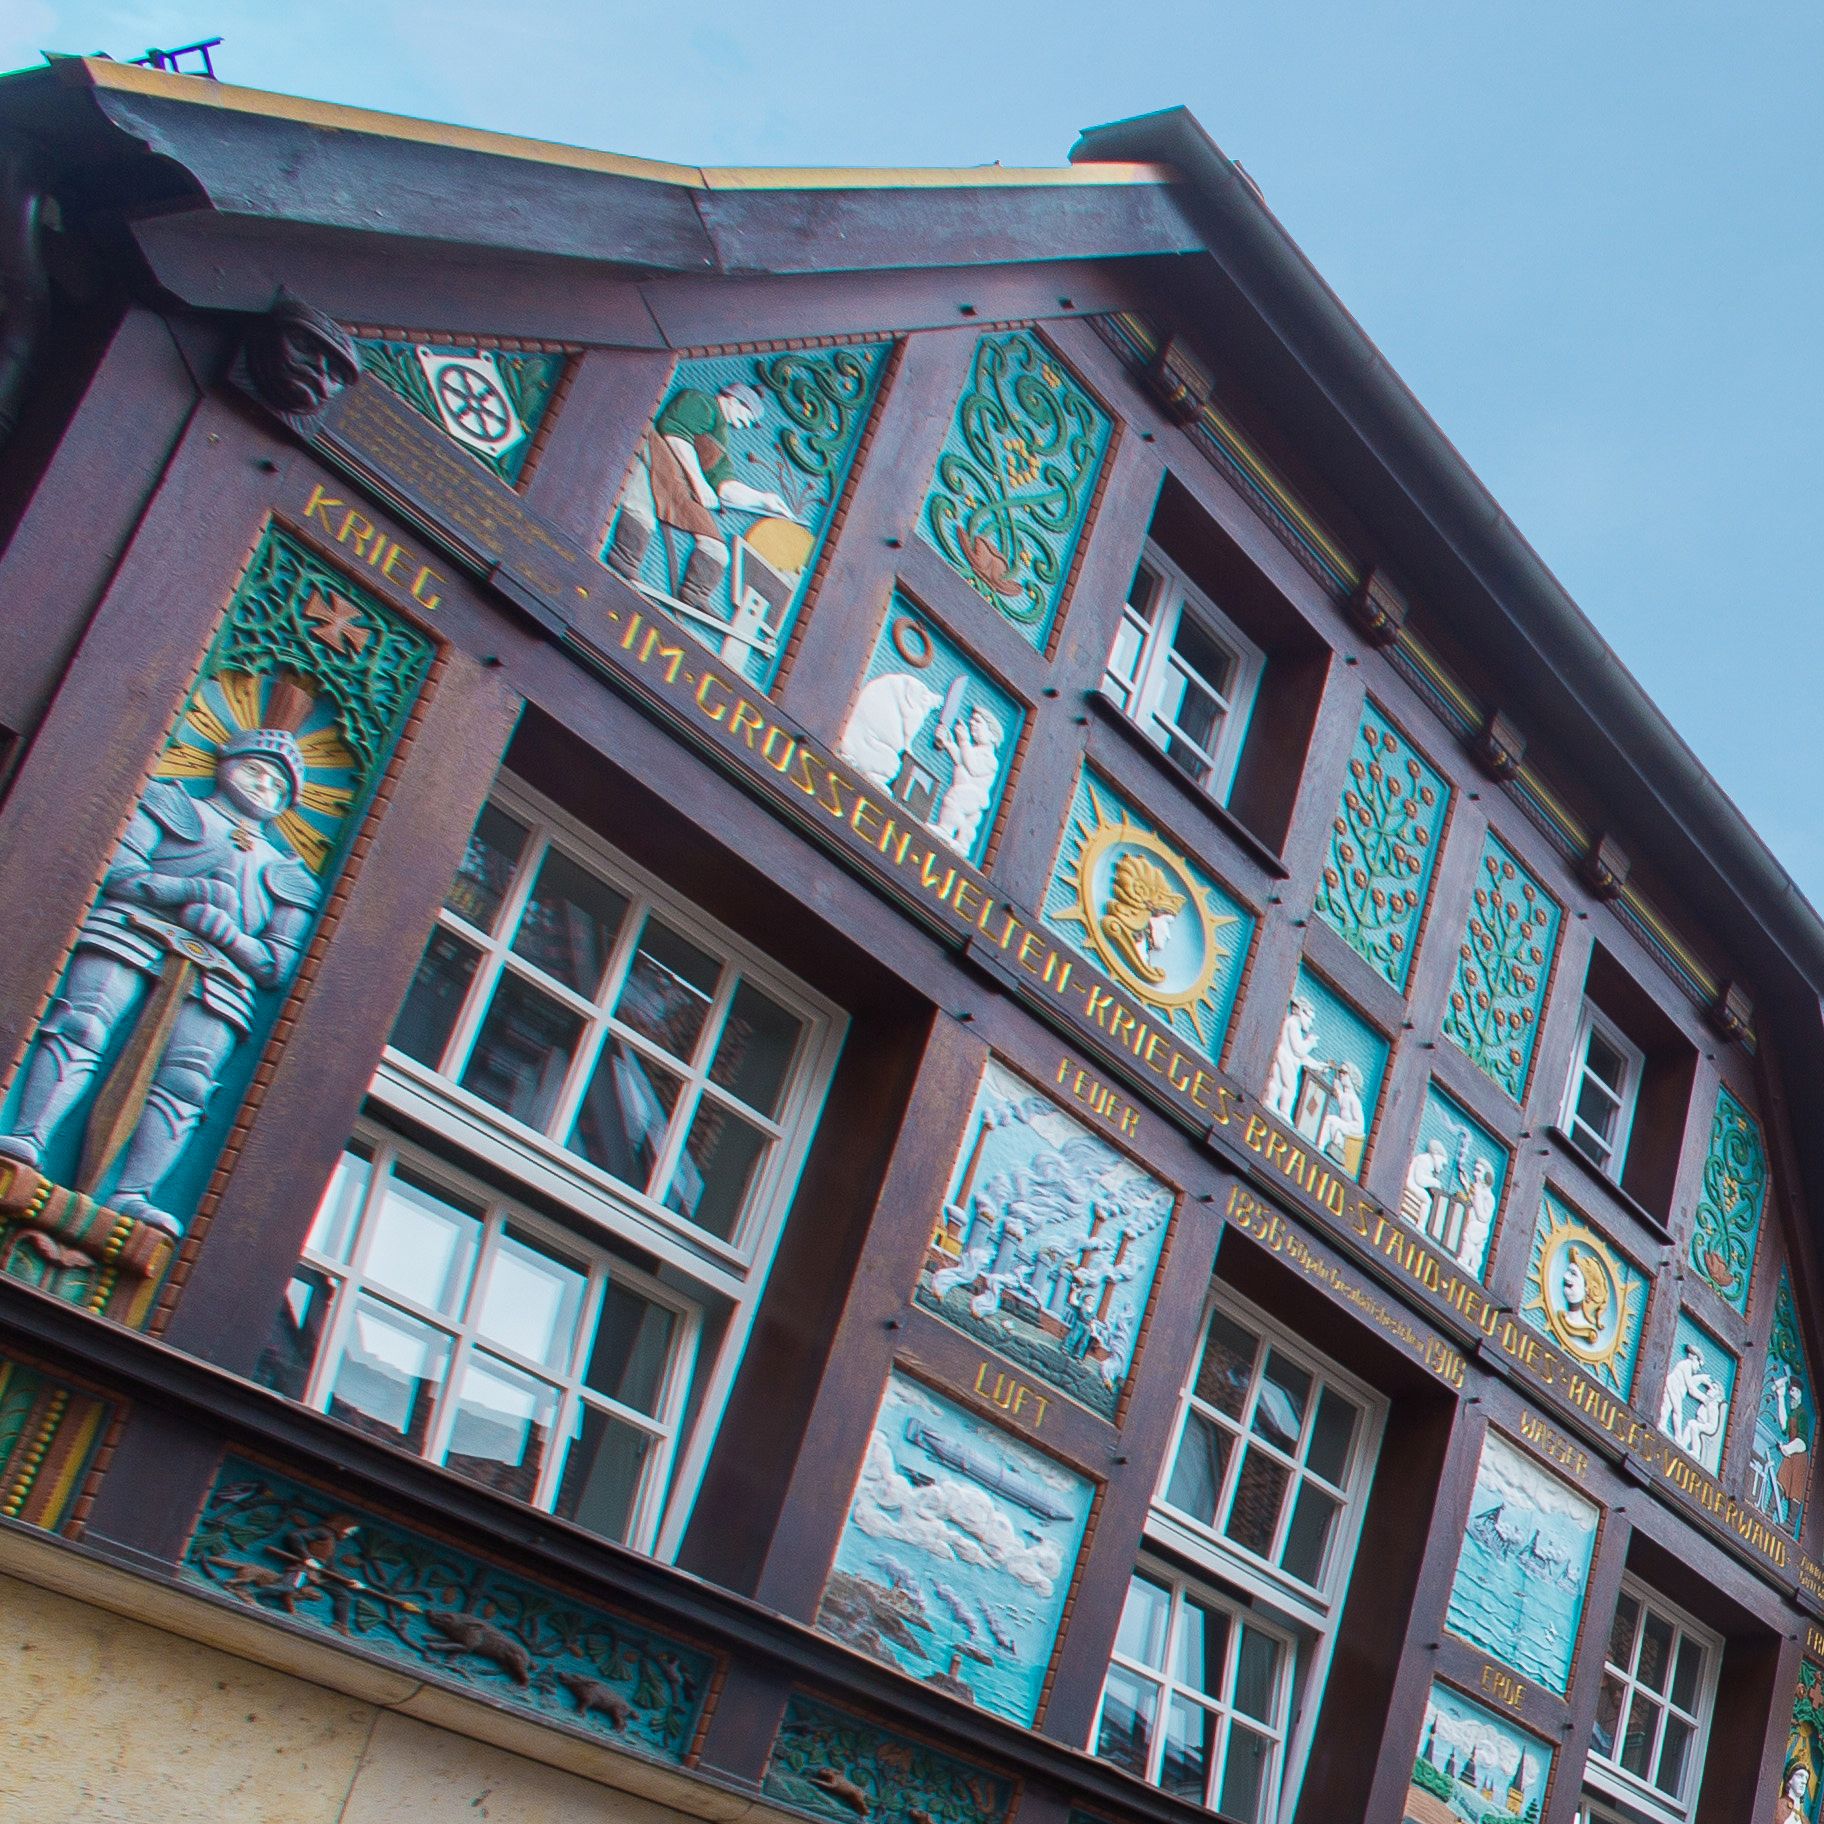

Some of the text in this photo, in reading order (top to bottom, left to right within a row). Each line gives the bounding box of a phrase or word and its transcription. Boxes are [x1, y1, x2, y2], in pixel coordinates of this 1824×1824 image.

[303, 483, 447, 611] KRIEG
[620, 611, 685, 685] IM
[695, 672, 912, 866] GROSSEN
[1352, 1201, 1440, 1293] STAND
[1448, 1276, 1499, 1337] NEU
[1568, 1375, 1655, 1462] HAUSES
[1055, 1056, 1140, 1138] FEUER
[1225, 1183, 1287, 1252] 1856
[974, 1359, 1053, 1429] LUFT
[1480, 1663, 1527, 1711] ERDE
